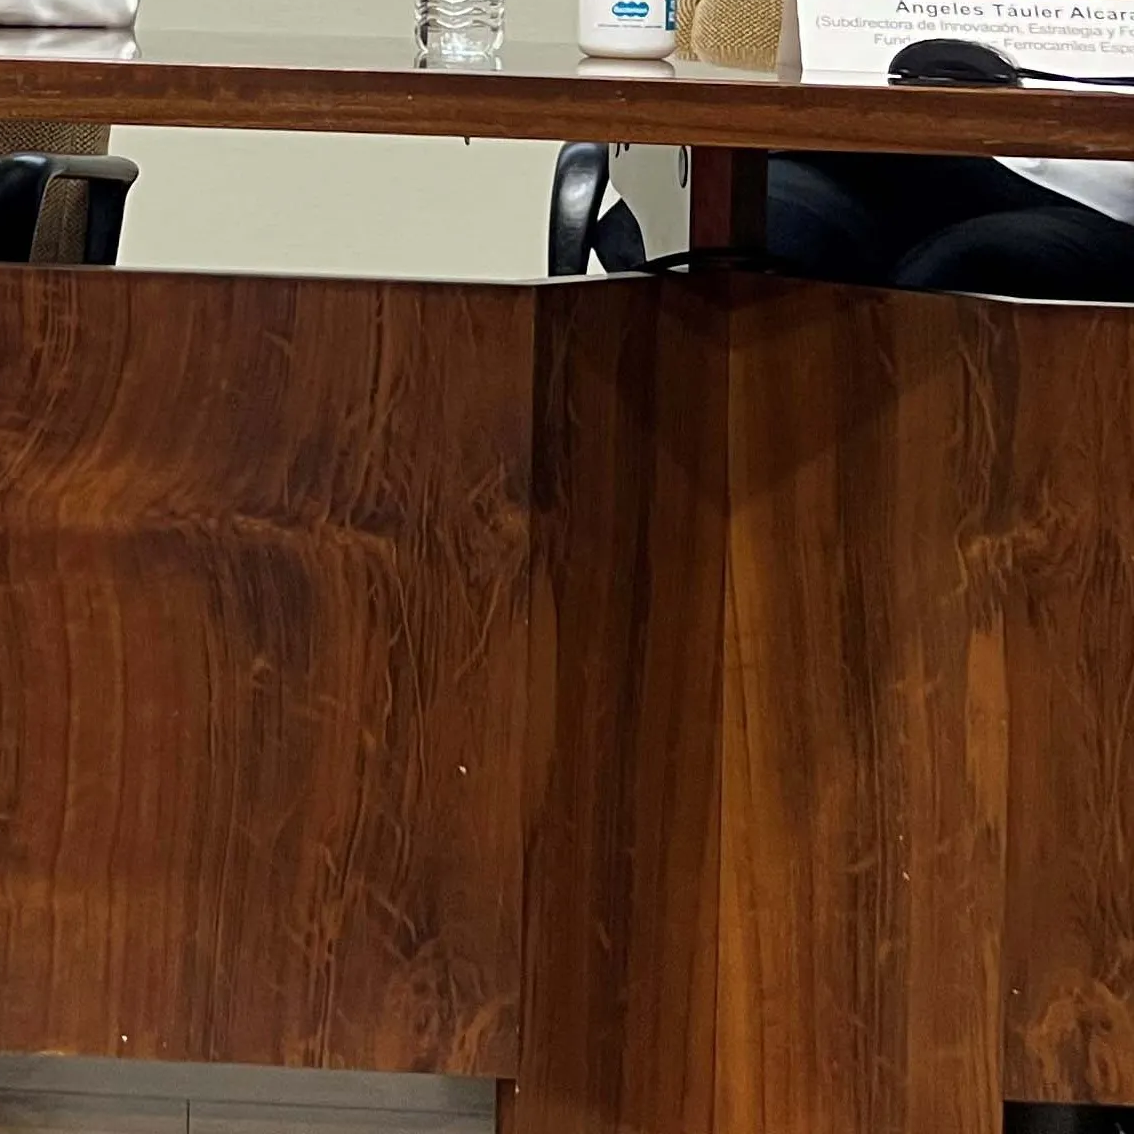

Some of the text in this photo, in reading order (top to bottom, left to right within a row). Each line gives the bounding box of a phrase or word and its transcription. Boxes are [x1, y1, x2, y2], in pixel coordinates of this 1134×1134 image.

[992, 3, 1063, 18] Táuler
[816, 15, 913, 30] (Subdirectora
[917, 19, 937, 31] de
[1028, 23, 1103, 38] Estrategia
[1106, 27, 1115, 39] y
